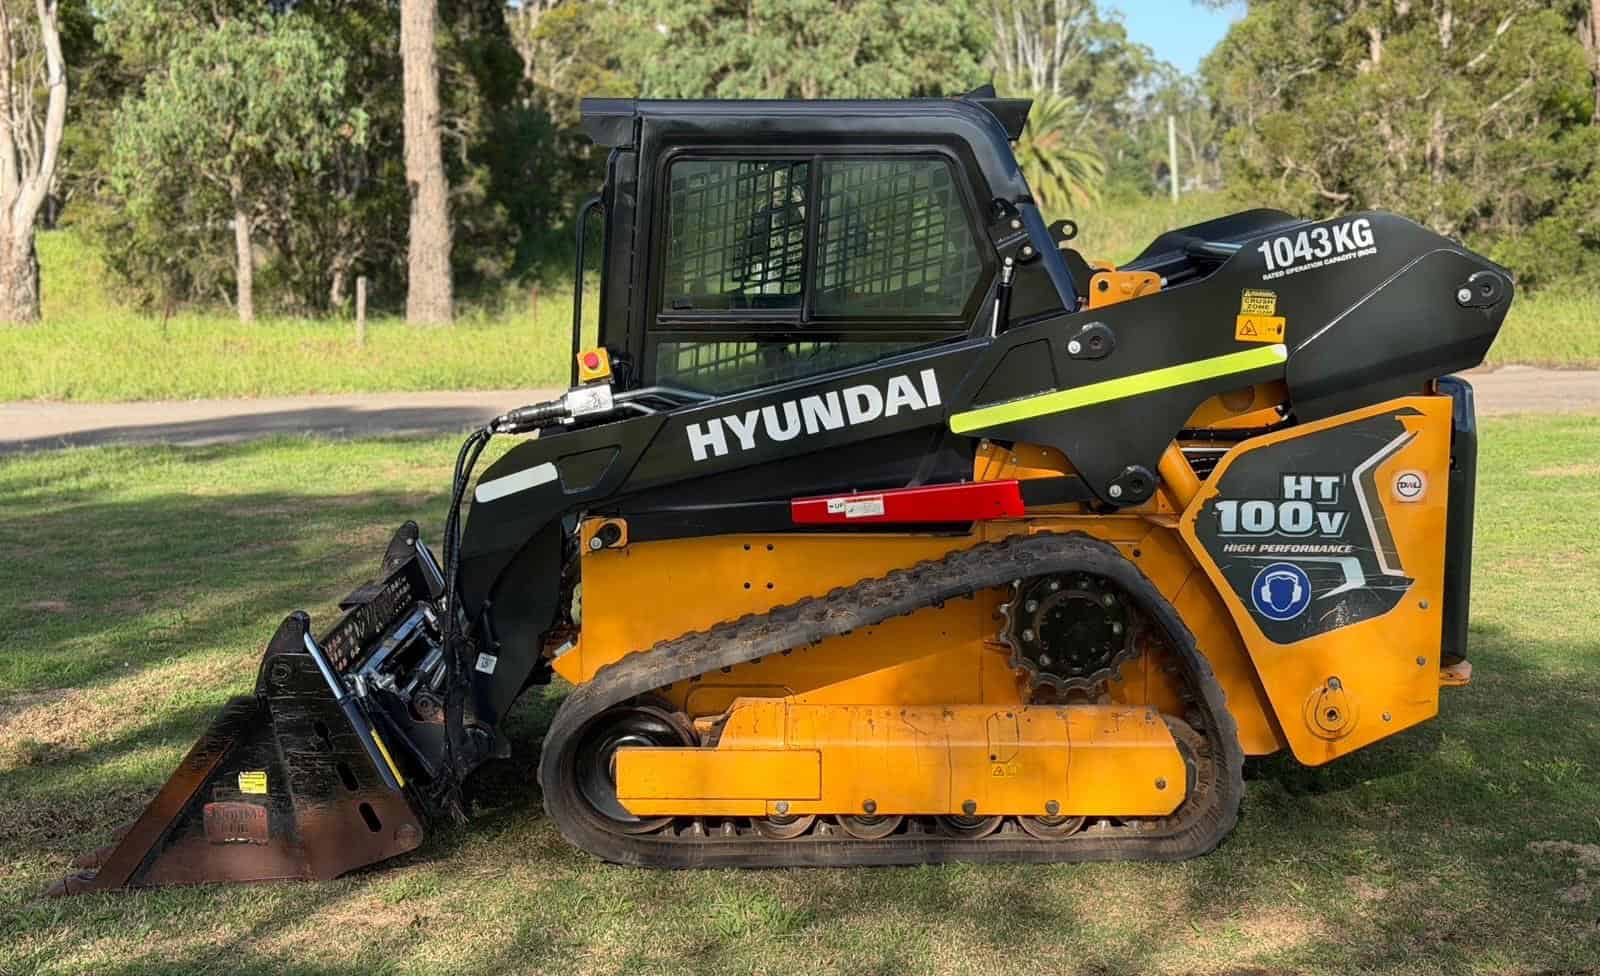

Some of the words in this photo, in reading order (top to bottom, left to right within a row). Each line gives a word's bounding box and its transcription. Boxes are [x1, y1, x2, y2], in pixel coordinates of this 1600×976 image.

[686, 367, 942, 462] HYUNDAI
[1283, 475, 1340, 500] HT
[1223, 543, 1257, 553] HIGH
[1259, 543, 1354, 554] PERFORMANCE
